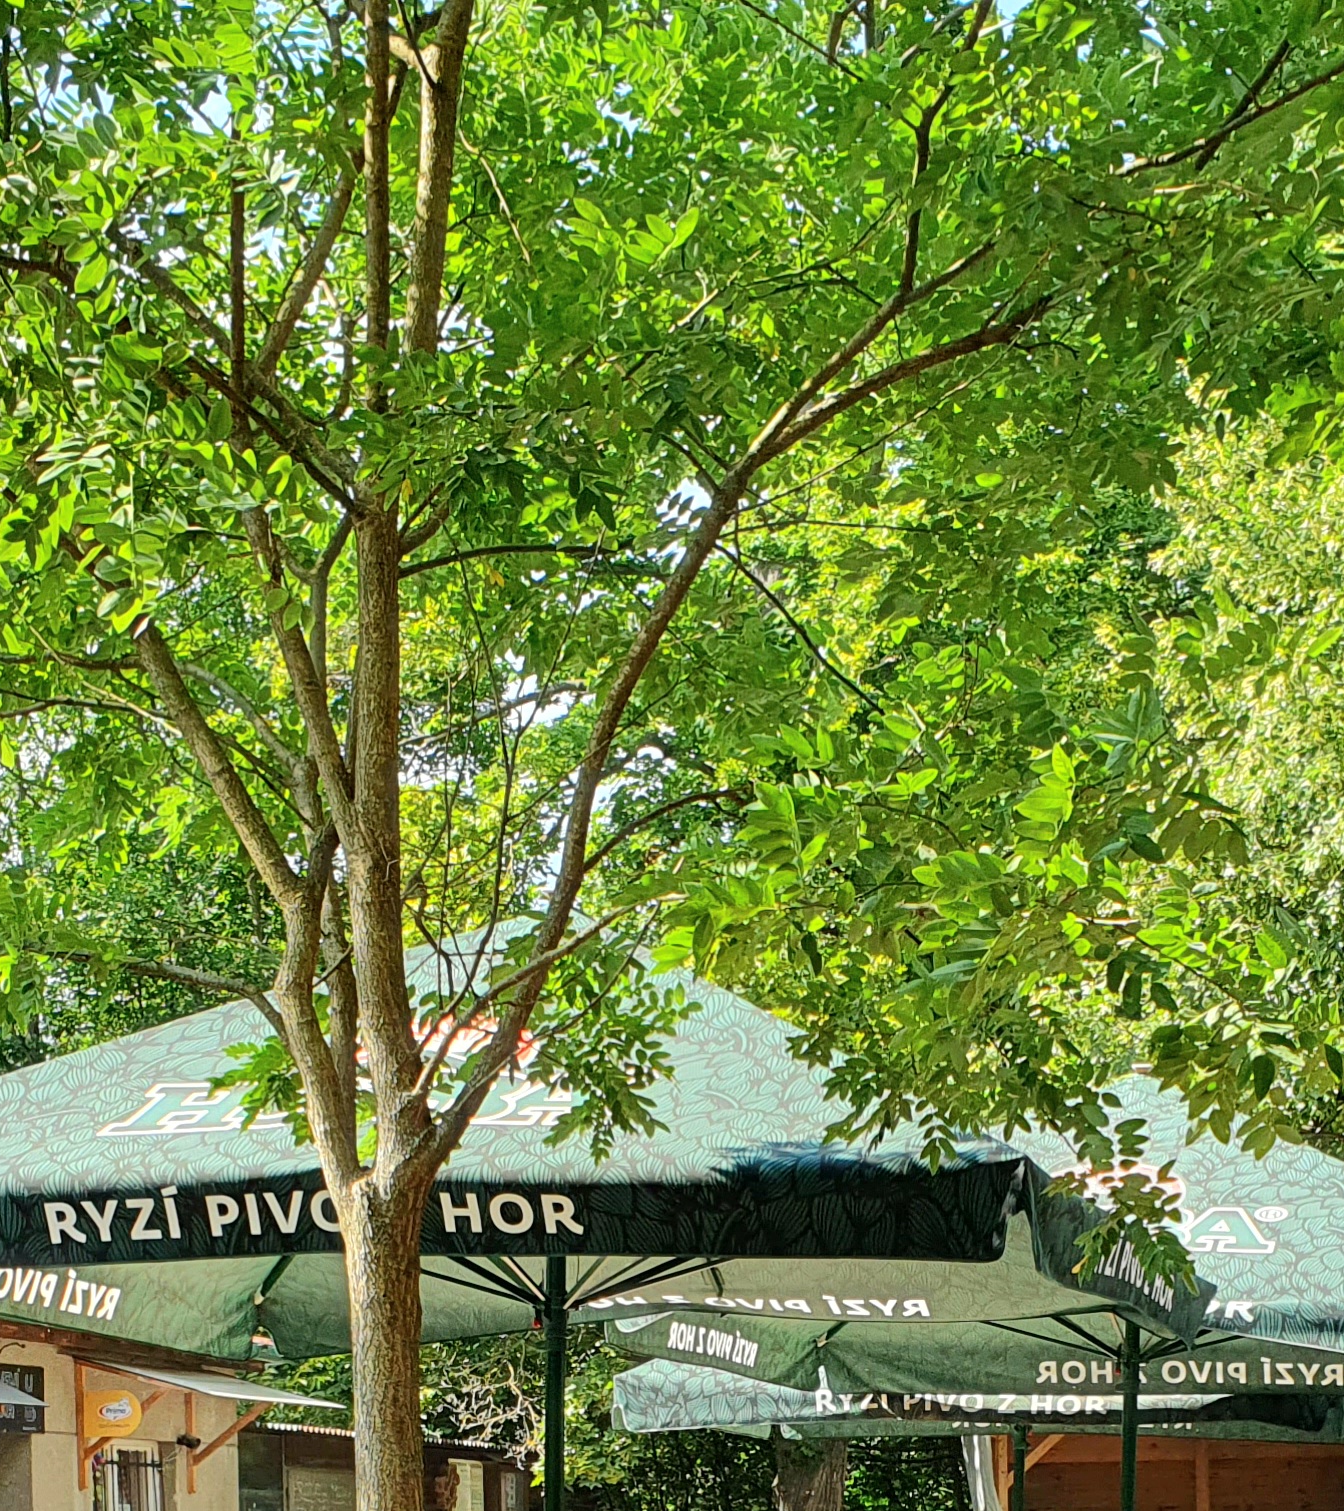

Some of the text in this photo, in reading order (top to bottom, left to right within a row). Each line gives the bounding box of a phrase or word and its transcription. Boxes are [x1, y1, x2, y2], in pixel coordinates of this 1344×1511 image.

[43, 1185, 182, 1244] RYZÍ
[441, 1192, 585, 1236] HOR
[1030, 1394, 1108, 1415] HOR
